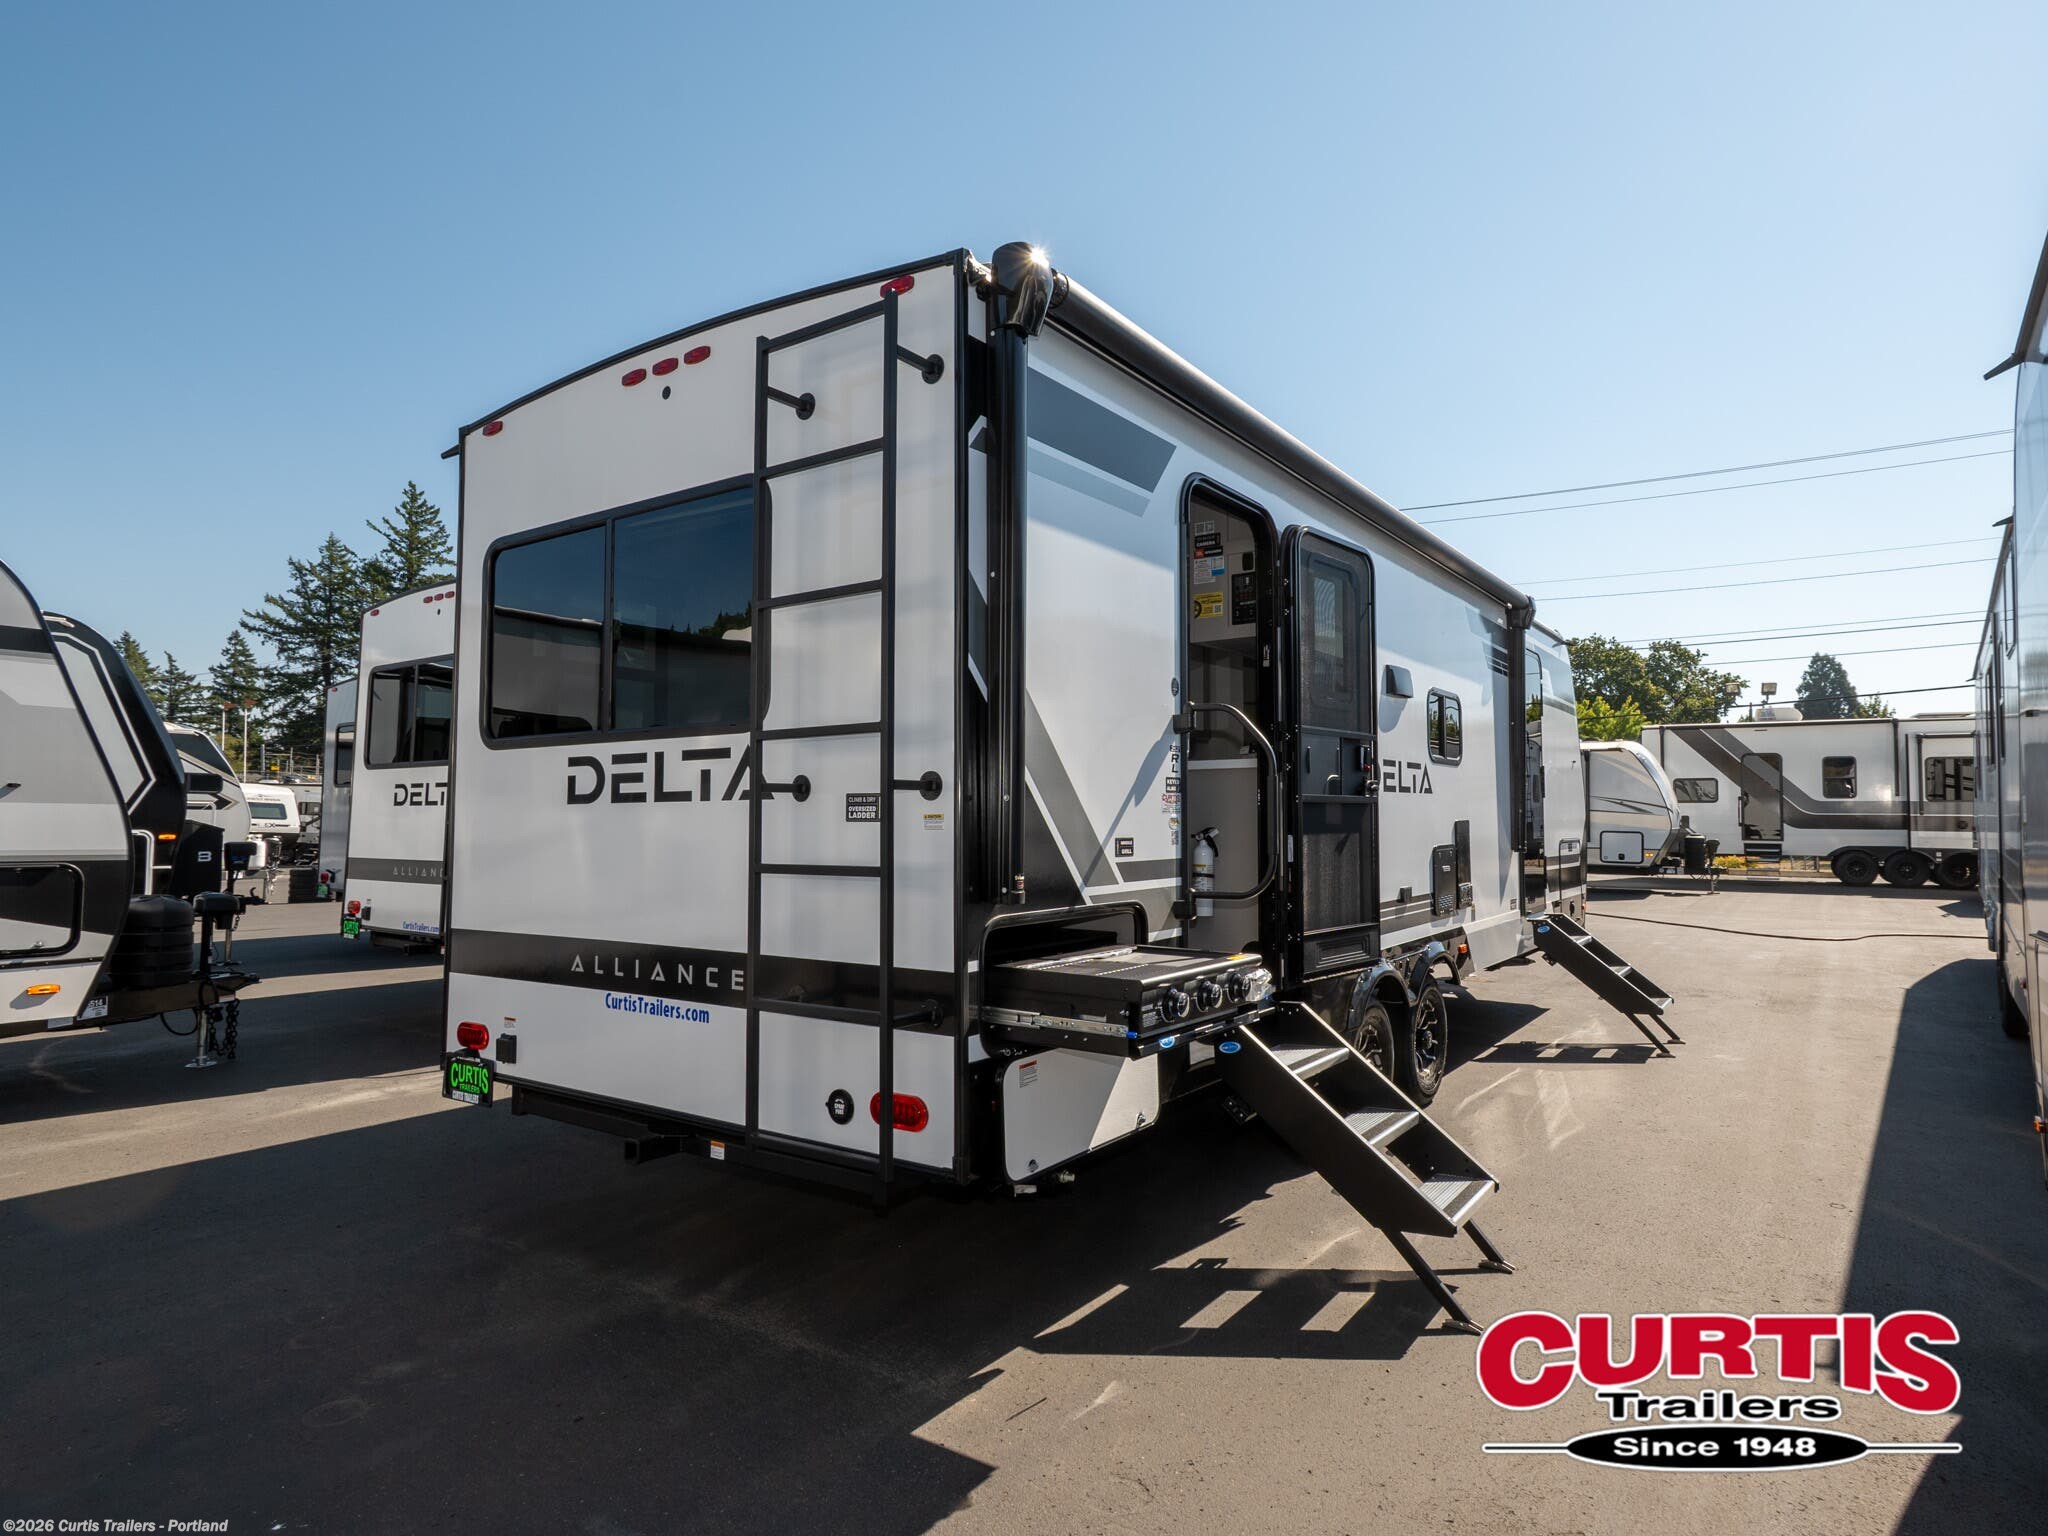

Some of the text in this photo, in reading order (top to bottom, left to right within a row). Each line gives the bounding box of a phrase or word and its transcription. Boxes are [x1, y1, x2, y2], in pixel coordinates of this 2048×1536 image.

[567, 744, 774, 804] DELTA
[1379, 758, 1433, 794] ELTA
[848, 811, 876, 819] LADDER
[570, 953, 745, 991] ALLIANCE
[605, 992, 710, 1024] CurtisTrailers.com
[450, 1062, 489, 1095] CURTIS
[459, 1083, 481, 1094] TRAILERS
